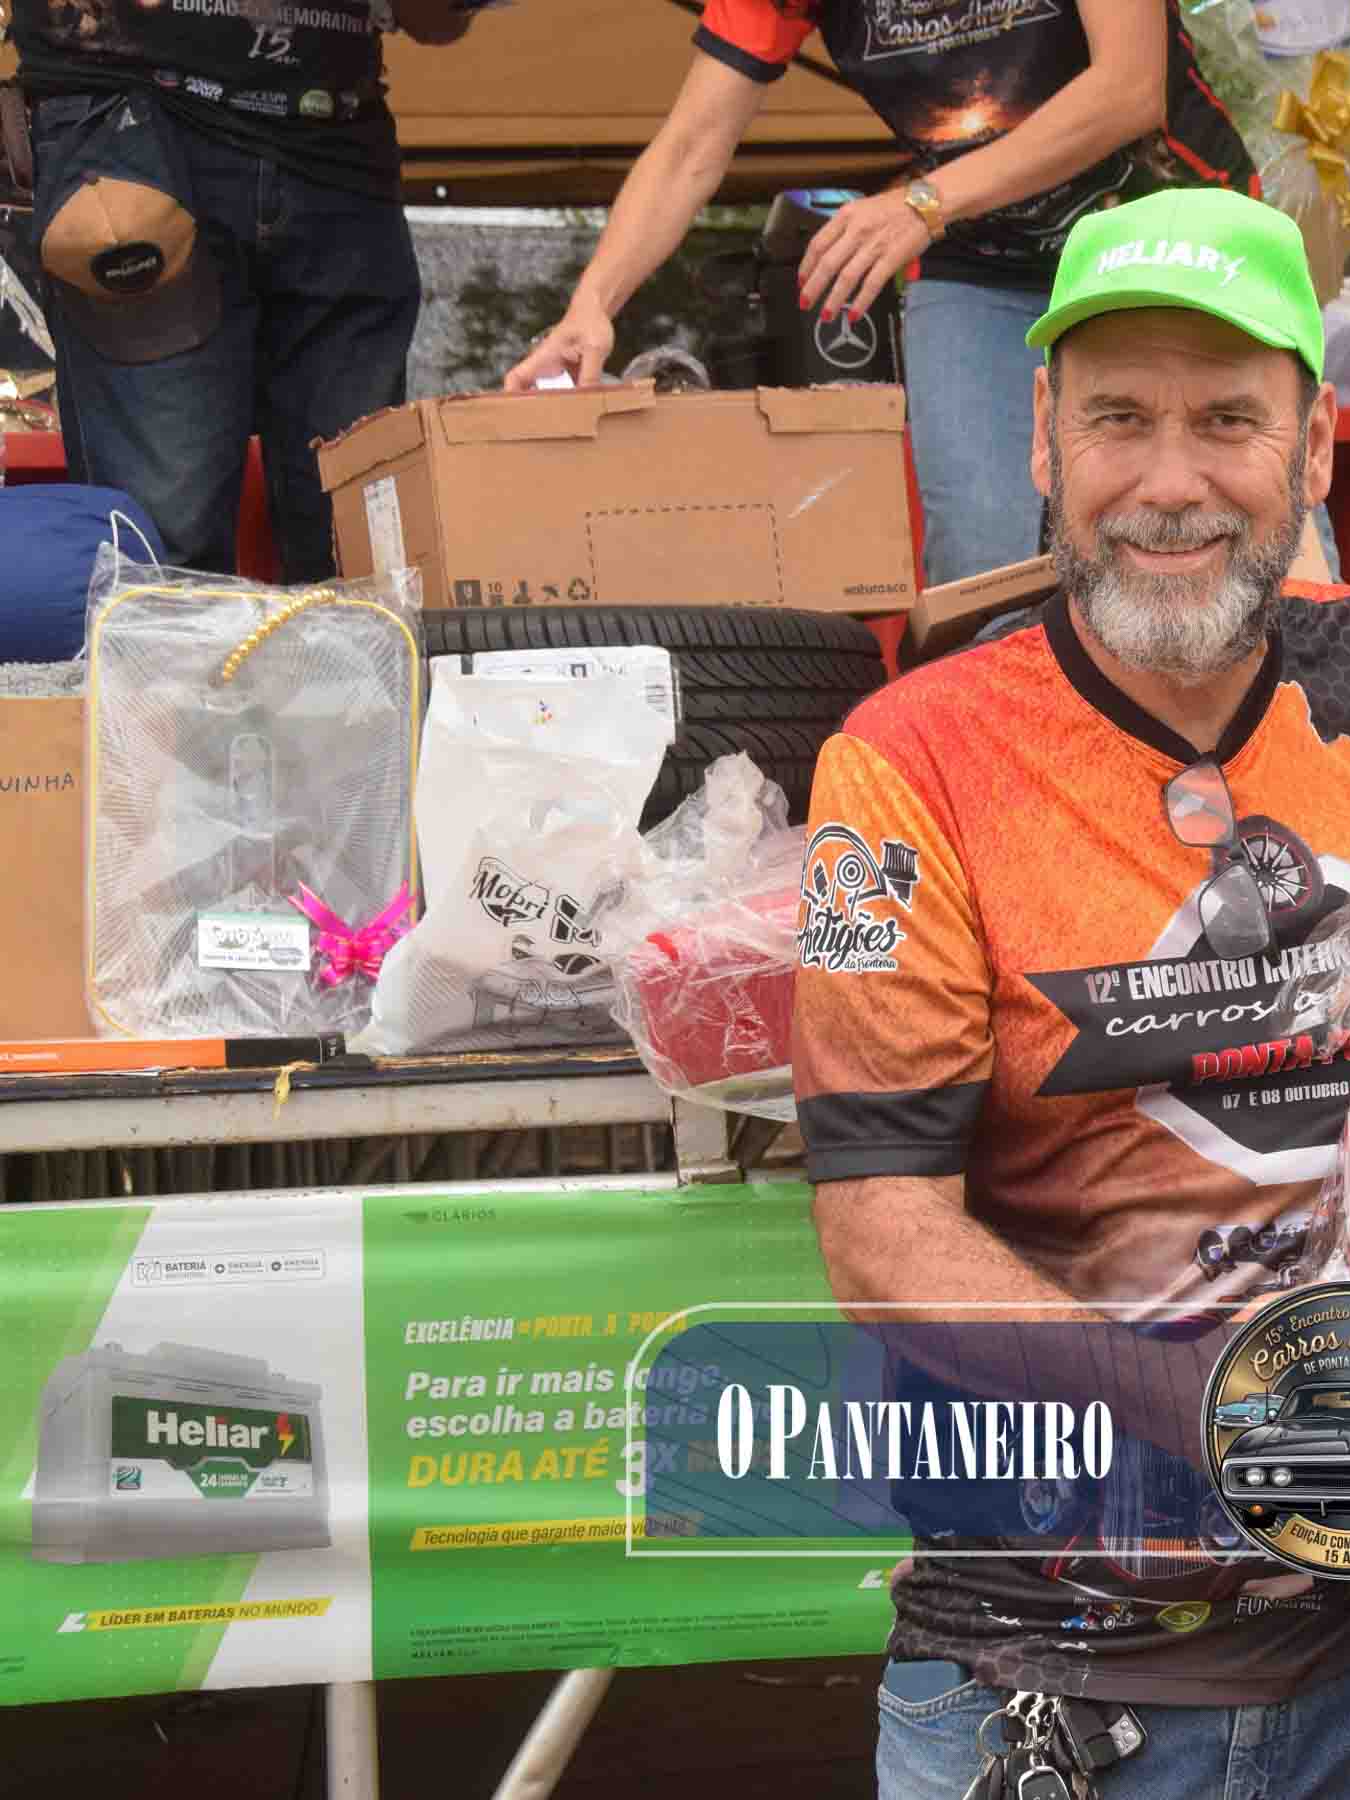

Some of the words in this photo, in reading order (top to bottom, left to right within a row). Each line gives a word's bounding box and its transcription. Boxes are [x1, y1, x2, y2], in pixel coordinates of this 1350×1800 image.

[248, 24, 294, 59] 15
[1097, 240, 1219, 275] HELIAR
[1126, 956, 1258, 1001] ENCONTRO
[1105, 1000, 1279, 1036] carros
[1249, 1089, 1259, 1106] E
[1261, 1088, 1281, 1106] 08
[1284, 1080, 1350, 1102] OUTUBRO
[404, 1316, 514, 1345] EXCELÊNCIA
[405, 1371, 487, 1401] Para
[496, 1367, 523, 1397] ir
[530, 1362, 615, 1394] mais
[147, 1410, 269, 1449] Heliar
[406, 1405, 545, 1439] escolha
[553, 1407, 575, 1432] a
[200, 1472, 218, 1489] 24
[407, 1449, 524, 1489] DURA
[531, 1438, 610, 1480] ATÉ
[423, 1527, 498, 1547] Tecnologia
[500, 1528, 529, 1546] que
[530, 1524, 585, 1544] garante
[587, 1519, 627, 1538] maior
[100, 1613, 141, 1628] LÍDER
[144, 1611, 165, 1625] EM
[168, 1606, 235, 1623] BATERIAS
[238, 1605, 259, 1618] NO
[262, 1601, 319, 1616] MUNDO
